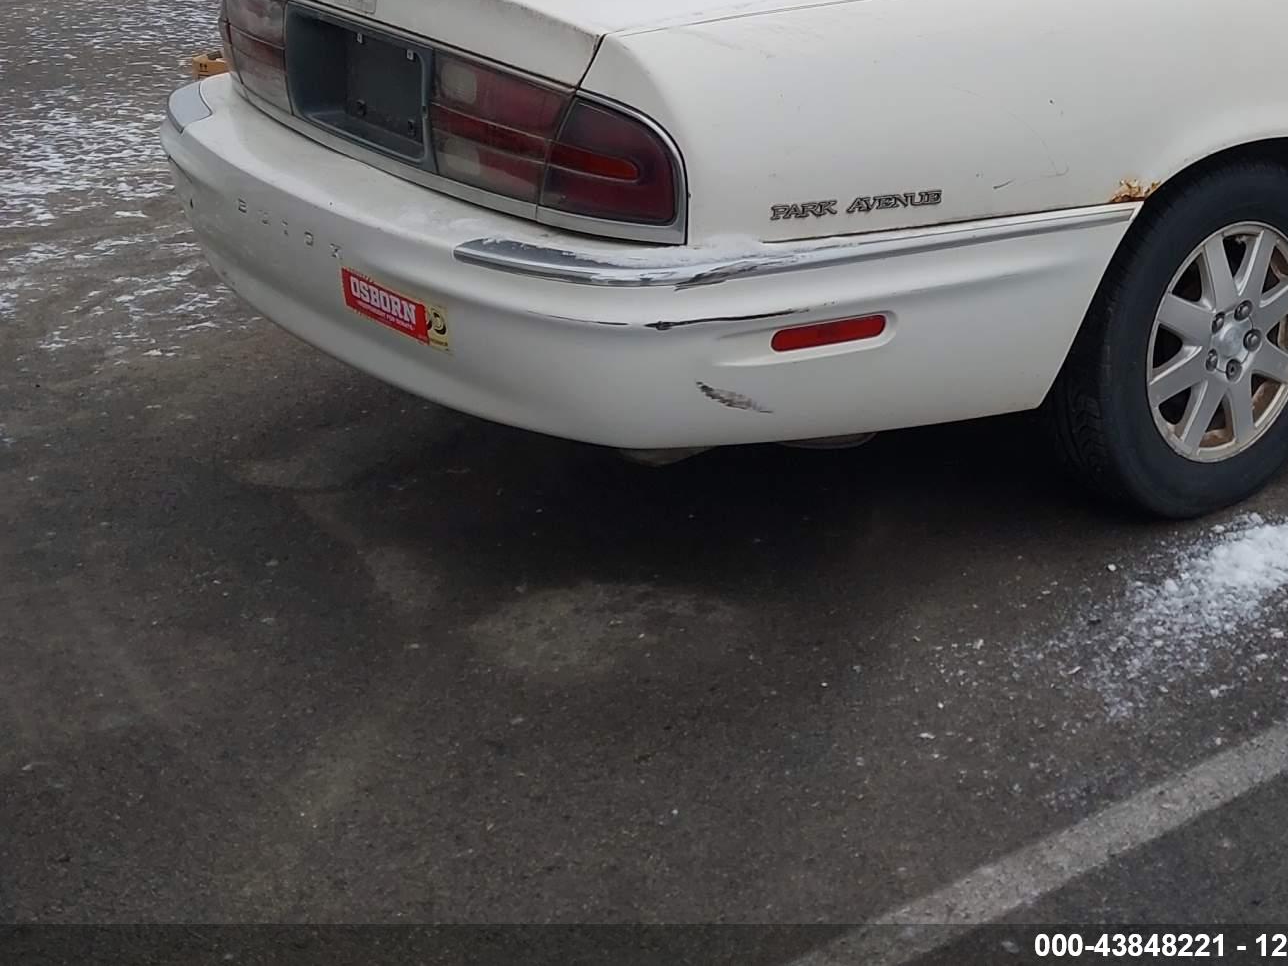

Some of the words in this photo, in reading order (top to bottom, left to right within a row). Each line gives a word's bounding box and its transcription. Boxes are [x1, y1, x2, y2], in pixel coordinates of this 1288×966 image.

[770, 199, 838, 221] PARK
[846, 189, 942, 214] AVENUE
[350, 275, 416, 325] OSBORN
